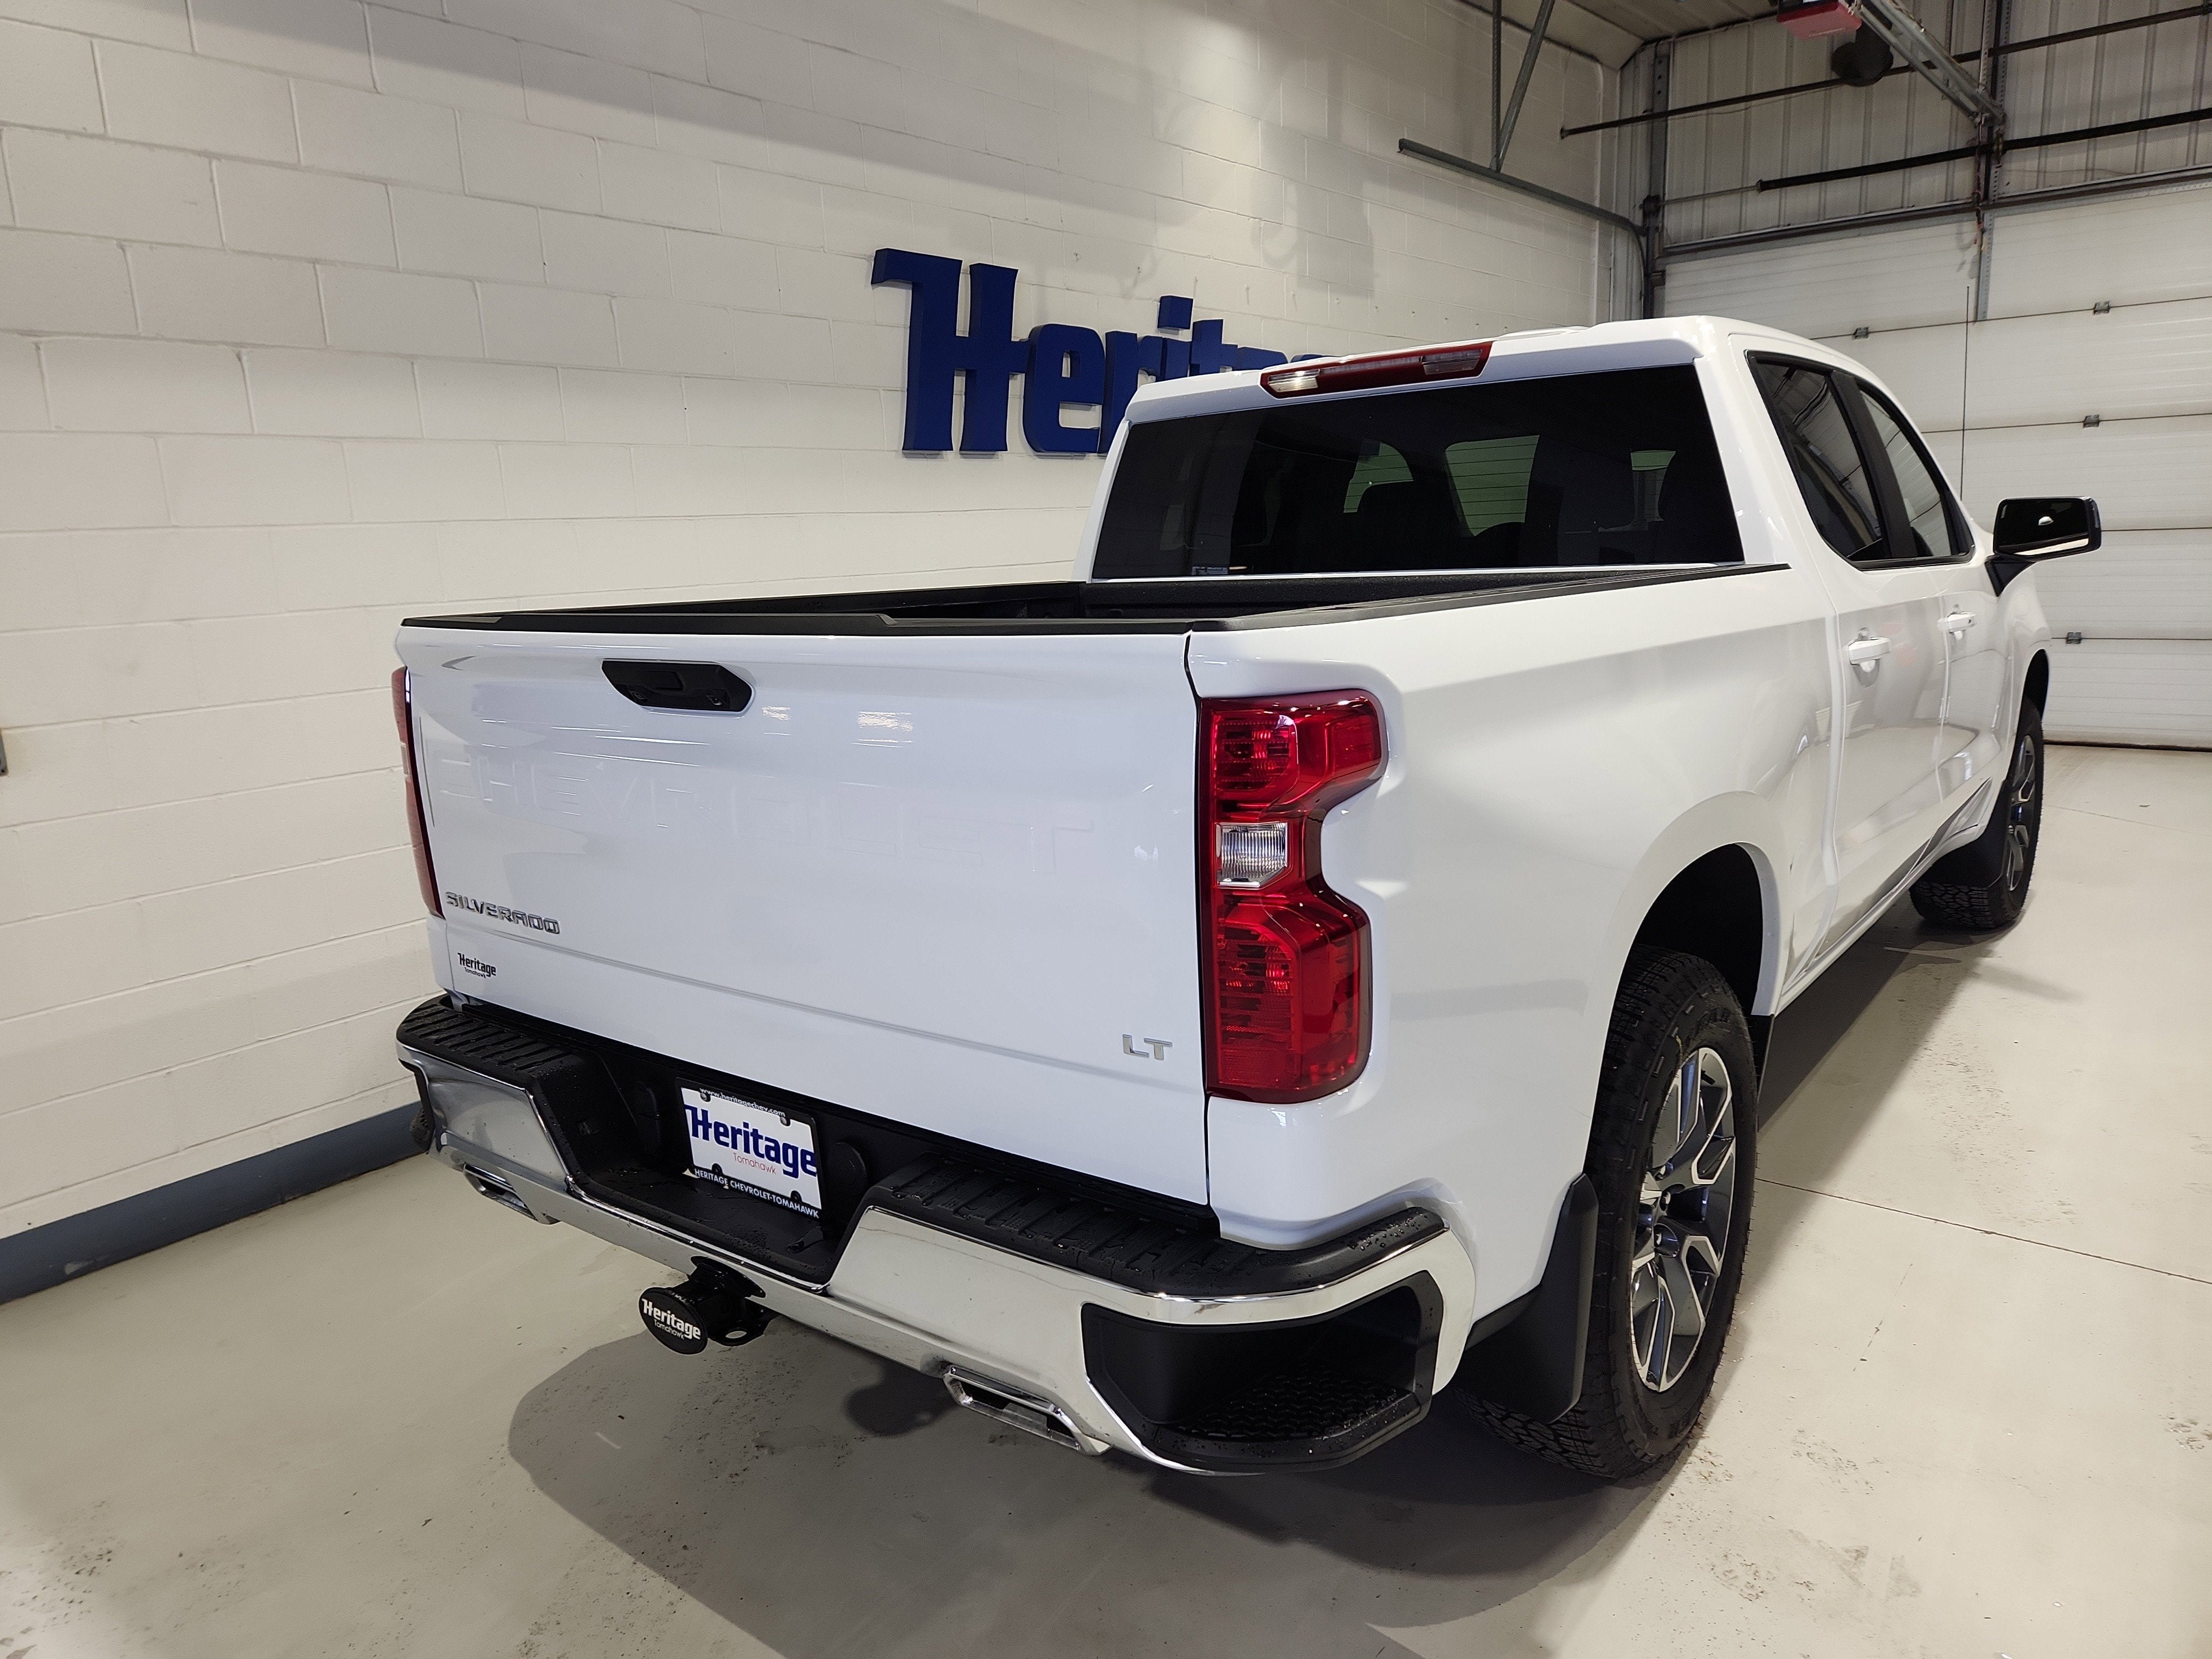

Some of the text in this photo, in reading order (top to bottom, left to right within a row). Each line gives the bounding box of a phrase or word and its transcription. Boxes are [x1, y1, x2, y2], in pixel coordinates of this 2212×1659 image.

[445, 891, 561, 935] SILVERADO
[458, 953, 496, 978] Heritage
[464, 967, 486, 978] Tomahawk
[1122, 1034, 1173, 1060] LT
[700, 1088, 786, 1117] www.heritagechev.com
[684, 1104, 817, 1179] Heritage
[732, 1152, 777, 1175] Tomahawk
[694, 1168, 820, 1219] HERITAGE CHEVROLET-TOMAHAWK
[642, 1298, 701, 1340] Heritage
[654, 1319, 684, 1340] Tomahawk
